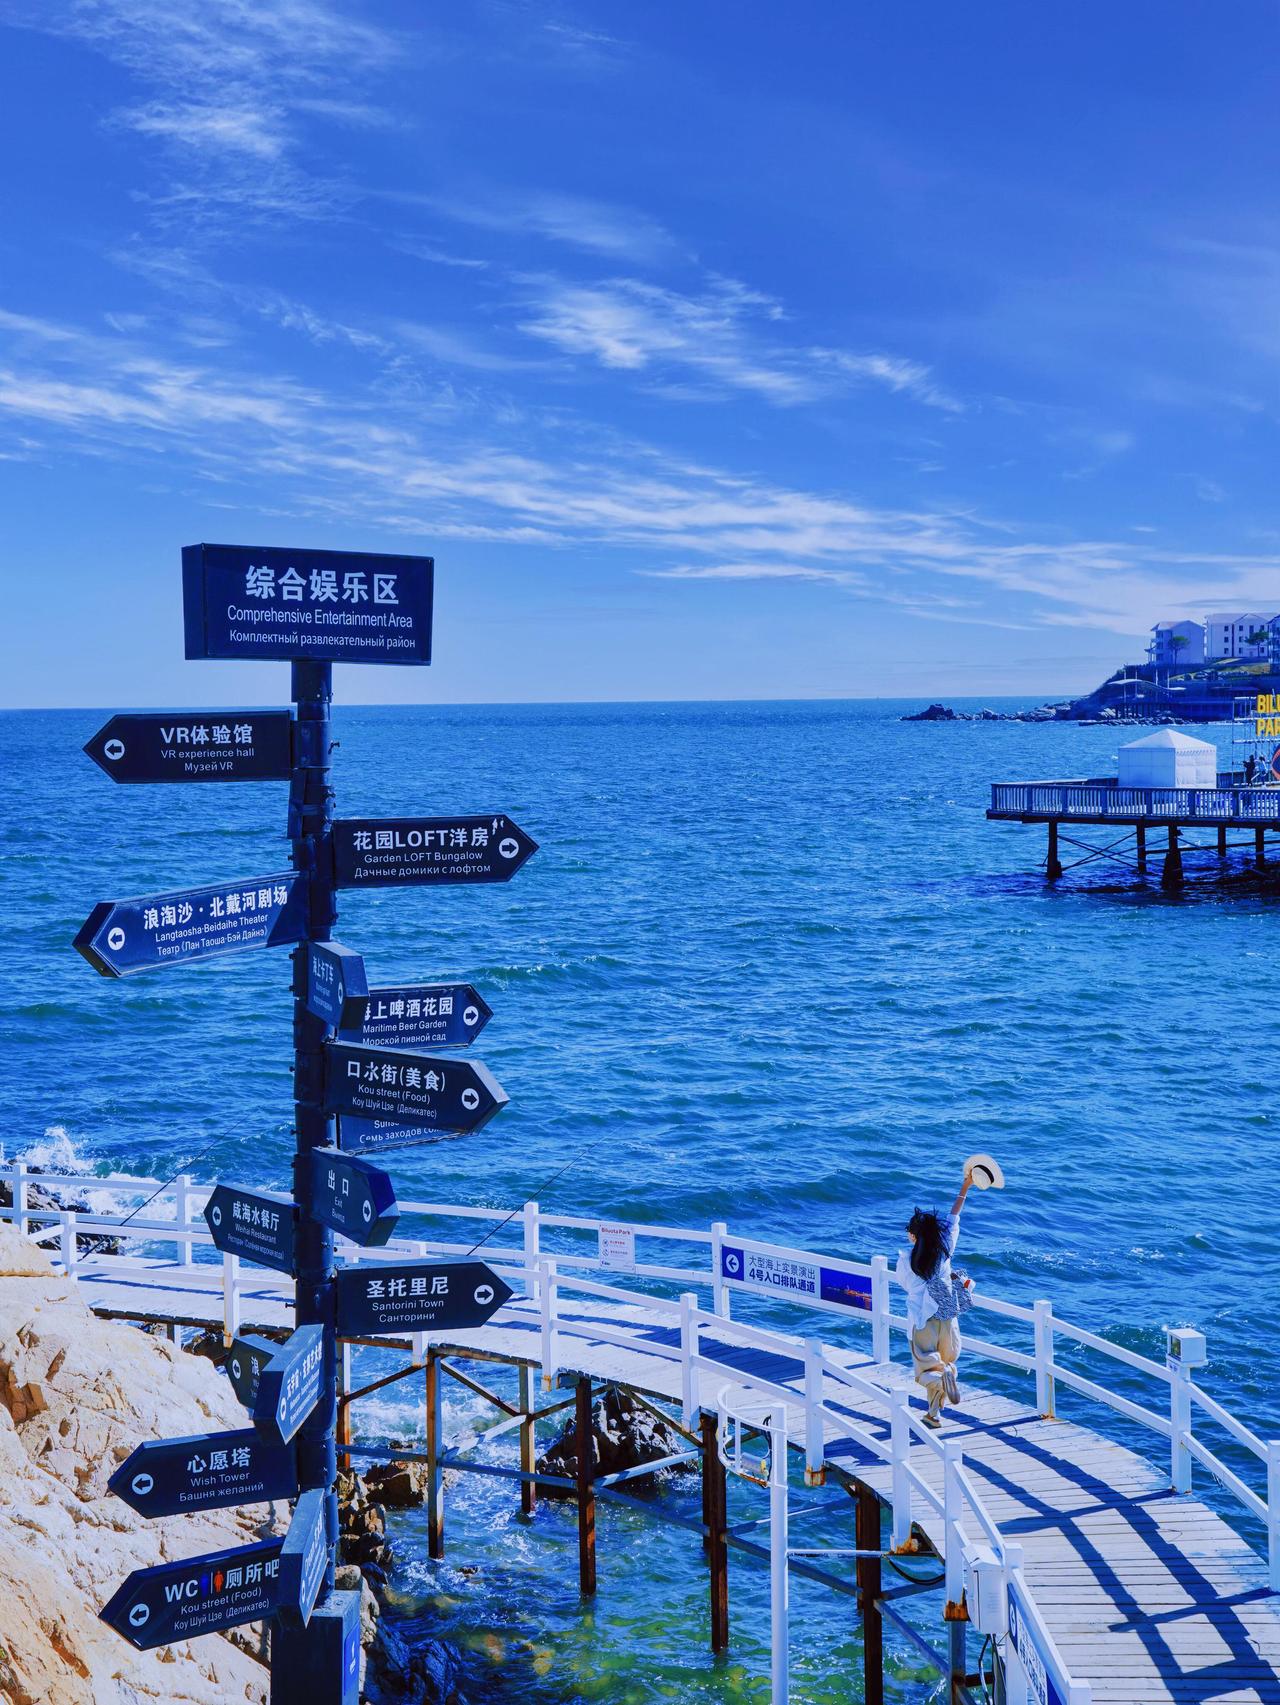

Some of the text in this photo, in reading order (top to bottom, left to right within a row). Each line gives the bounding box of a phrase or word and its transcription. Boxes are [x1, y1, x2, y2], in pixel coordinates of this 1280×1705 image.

[245, 565, 399, 605] 综合娱乐区
[227, 605, 413, 628] Comprehensive Entertainment Area
[229, 629, 416, 649] Комплектный развлекательный район
[160, 724, 253, 745] VR体验馆
[161, 747, 254, 759] VR experience hall
[184, 761, 233, 774] Музей VR
[353, 827, 489, 851] 花园LOFT洋房
[364, 851, 483, 863] Garden LOFT Bungalow
[354, 867, 397, 879] Дачные
[399, 867, 440, 877] домики
[449, 864, 491, 875] лофтом
[240, 914, 269, 926] Theater
[157, 945, 180, 956] Театр
[363, 1020, 447, 1033] Maritime Beer Garden
[401, 1033, 430, 1043] пивной
[431, 1033, 446, 1041] сад
[347, 1060, 446, 1092] 口水街(美食)
[352, 1097, 364, 1108] Коу
[358, 1084, 431, 1104] Kou street (Food)
[385, 1129, 422, 1140] заходов
[327, 1169, 349, 1196] 出口
[749, 1255, 816, 1280] 大型海上实景演出
[366, 1276, 449, 1299] 圣托里尼
[749, 1268, 815, 1294] 4号入口排队通道
[372, 1299, 444, 1311] Santorini Town
[379, 1312, 435, 1323] Санторини
[186, 1446, 251, 1474] 心愿塔
[190, 1472, 250, 1487] Wish Tower
[179, 1482, 264, 1502] Башня желаний
[164, 1579, 199, 1603] WC
[225, 1559, 280, 1589] 厕所吧
[181, 1587, 262, 1615] Kou street (Food)
[174, 1598, 270, 1631] Коу Шуй Цзе (Деликатес)
